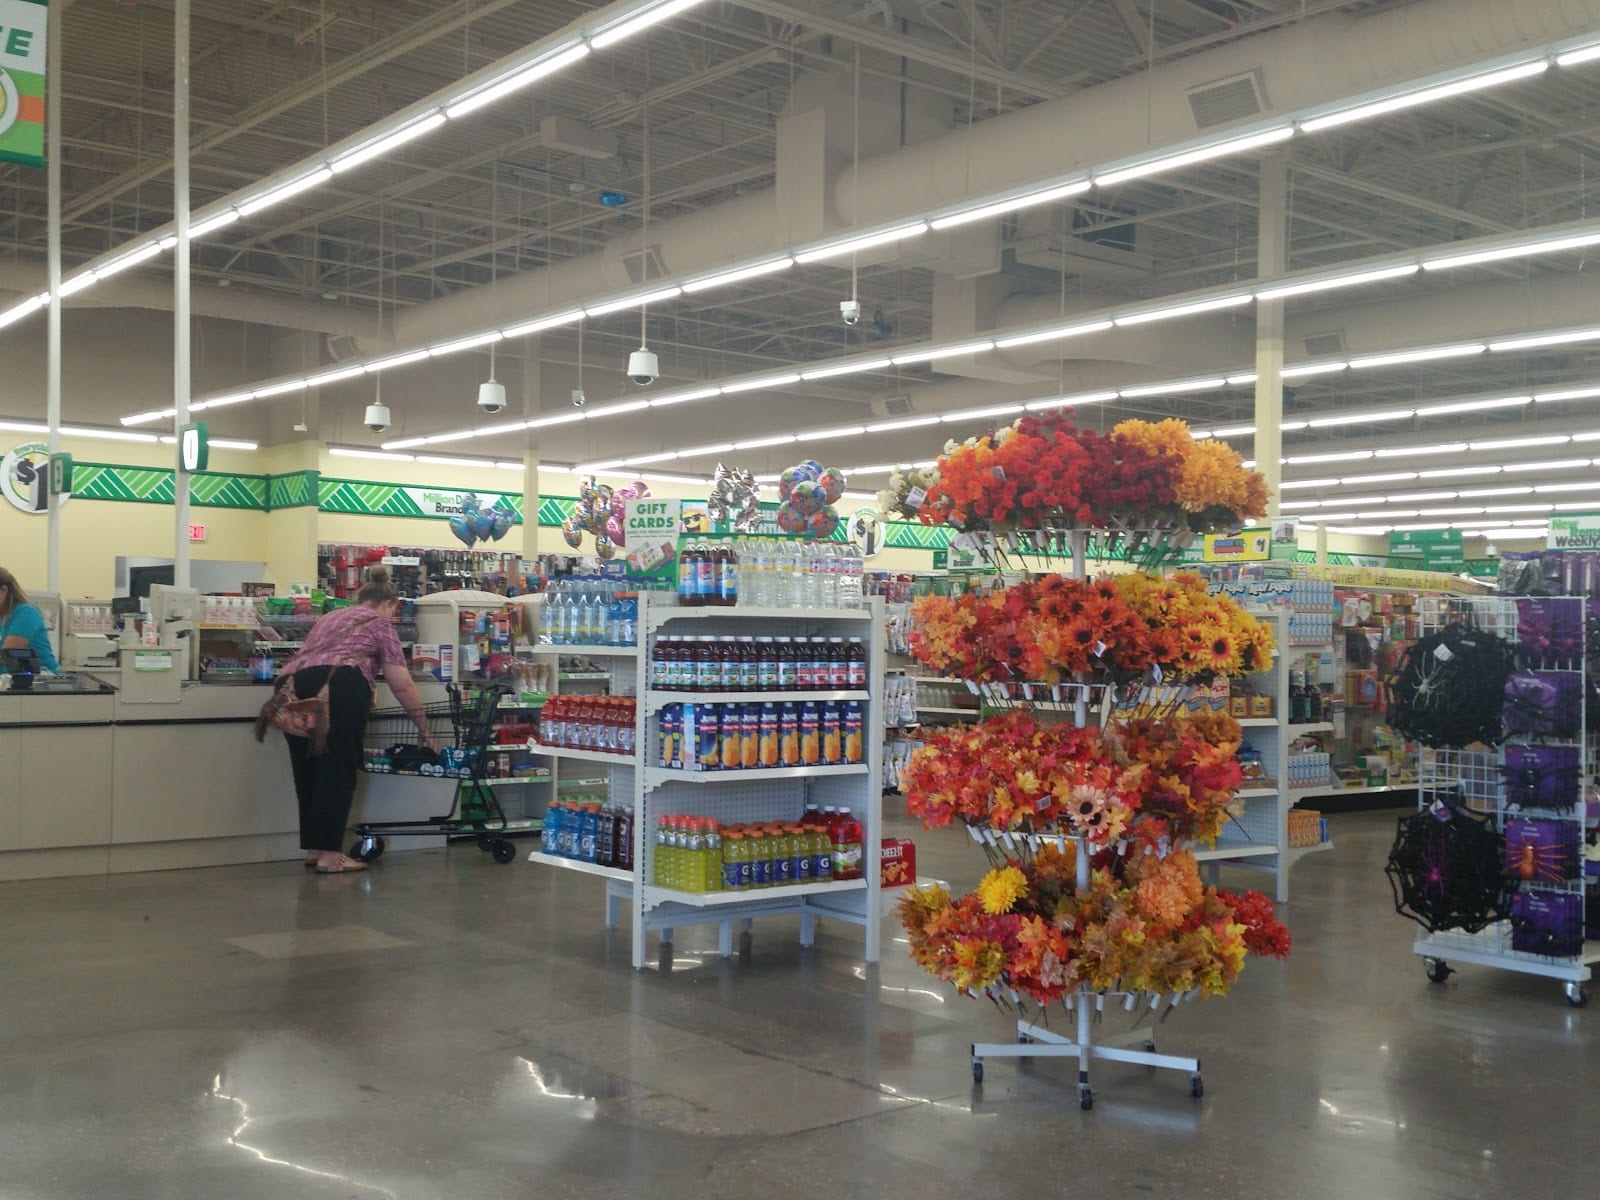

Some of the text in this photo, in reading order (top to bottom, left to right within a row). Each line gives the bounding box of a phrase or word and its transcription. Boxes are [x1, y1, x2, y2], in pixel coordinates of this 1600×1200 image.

[0, 25, 34, 58] E
[636, 503, 667, 515] GIFT
[629, 517, 674, 529] CARDS
[800, 859, 809, 870] G
[820, 857, 830, 868] G
